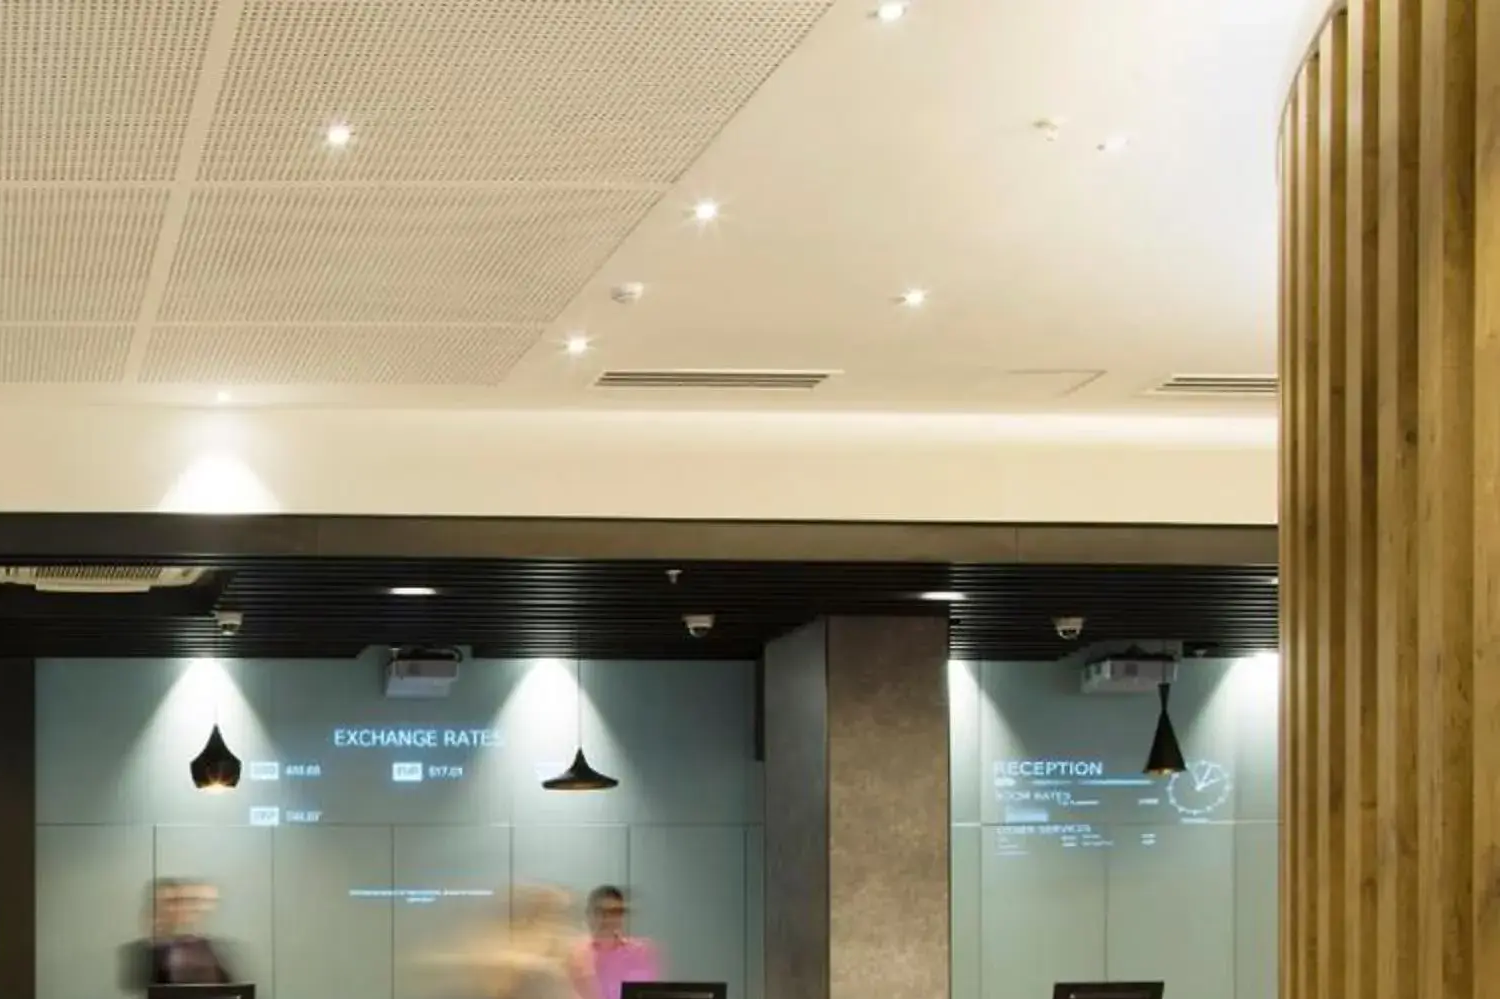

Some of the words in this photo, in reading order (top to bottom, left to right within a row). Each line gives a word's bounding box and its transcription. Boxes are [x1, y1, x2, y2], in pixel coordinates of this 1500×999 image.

[333, 729, 438, 747] EXCHANGE
[443, 729, 506, 748] RATES
[994, 761, 1103, 776] RECEPTION
